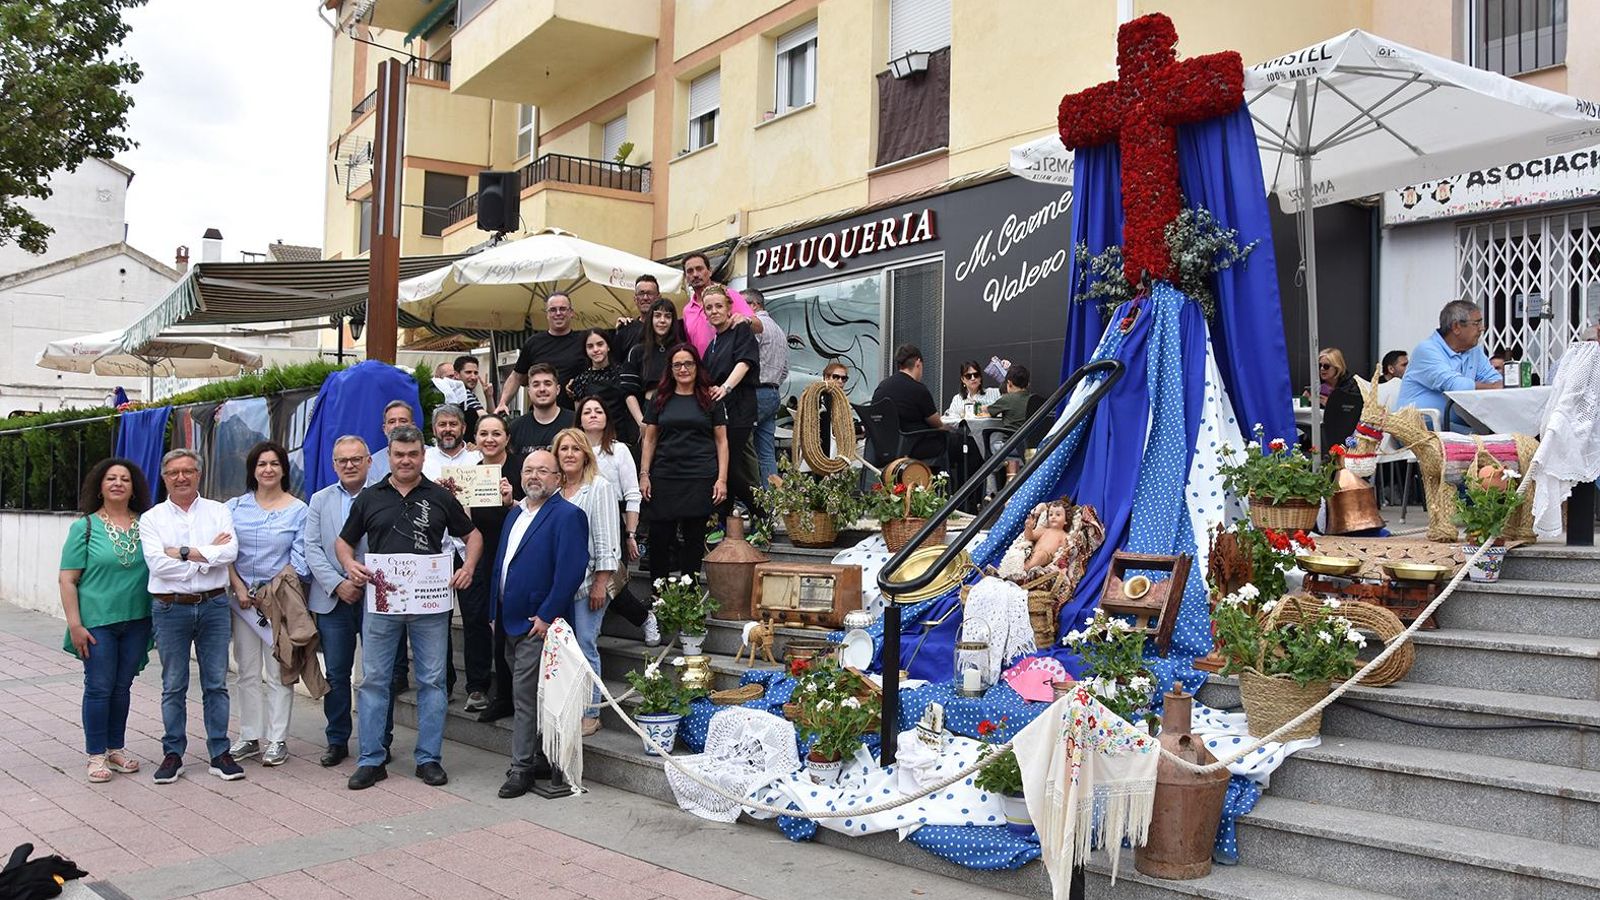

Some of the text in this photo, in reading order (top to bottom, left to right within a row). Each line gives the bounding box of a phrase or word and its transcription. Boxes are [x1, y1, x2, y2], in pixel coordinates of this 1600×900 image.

[1289, 66, 1318, 79] MALTA
[1466, 150, 1600, 189] ASOCIACI
[752, 208, 934, 277] PELUQUERIA
[955, 190, 1074, 281] M. Carme
[983, 249, 1066, 312] Valero
[414, 586, 449, 594] PRIMER
